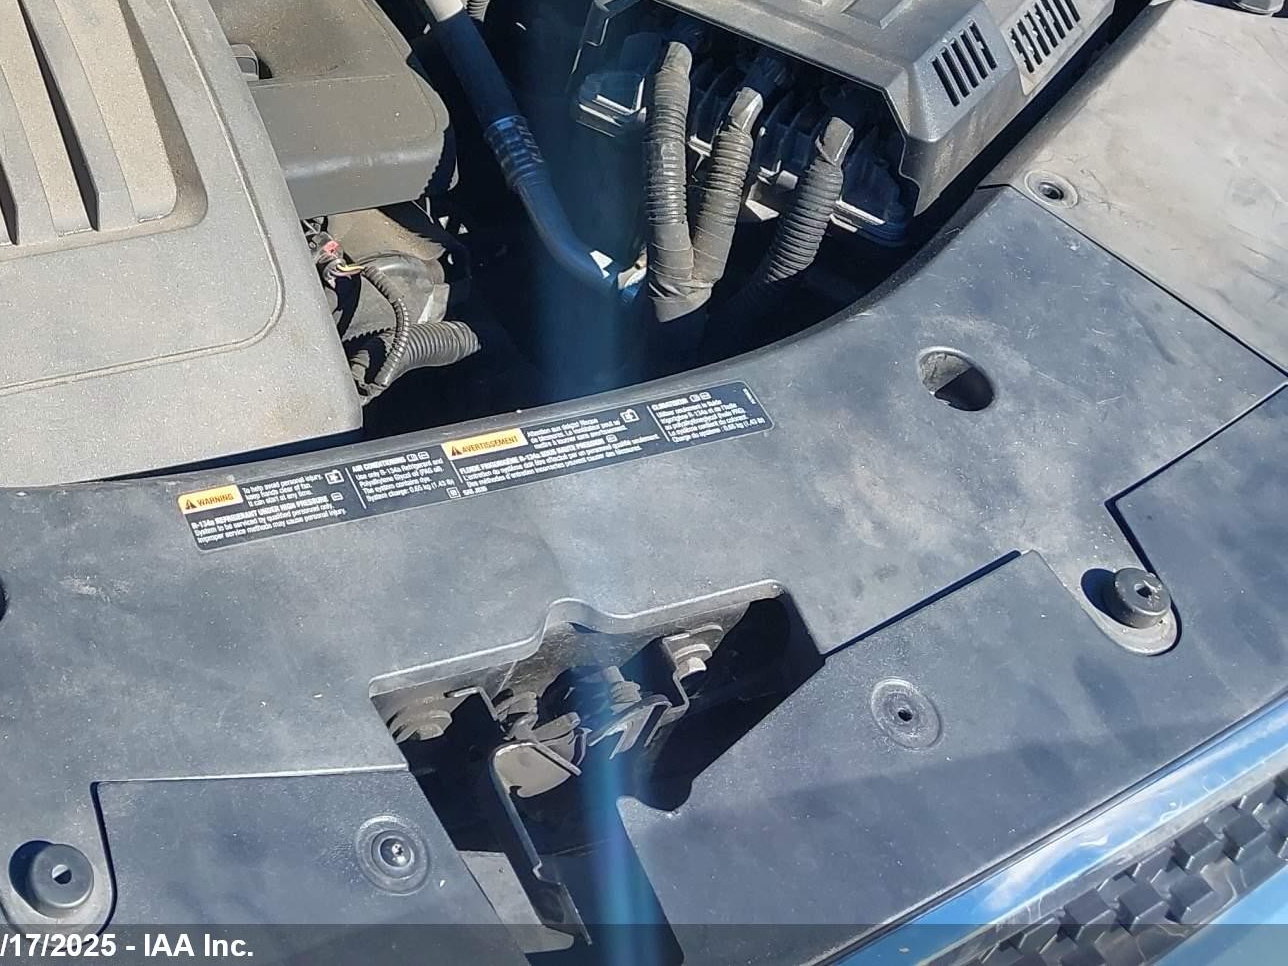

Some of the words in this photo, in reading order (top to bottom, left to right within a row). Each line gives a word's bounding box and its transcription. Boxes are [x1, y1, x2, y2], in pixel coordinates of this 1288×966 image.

[462, 436, 518, 453] AVERTISSEMENT
[363, 457, 406, 470] CONDITIONING
[367, 471, 380, 479] only
[380, 467, 401, 475] R-134a
[401, 460, 432, 472] Refrigerant
[251, 485, 264, 494] help
[264, 482, 280, 490] avoid
[281, 477, 305, 488] personal
[305, 473, 323, 483] injury.
[394, 473, 412, 481] Glycol
[374, 484, 396, 493] system
[395, 479, 419, 488] contains
[197, 494, 234, 506] WARNING
[245, 493, 260, 501] keep
[367, 493, 388, 502] System
[388, 489, 409, 498] charge:
[191, 519, 215, 529] R-134a
[215, 510, 258, 524] REFRIGERANT
[258, 506, 280, 515] UNDER
[280, 502, 296, 511] HIGH
[296, 496, 329, 508] PRESSURE
[194, 527, 217, 537] System
[233, 519, 258, 528] serviced
[266, 511, 292, 523] qualified
[292, 506, 320, 518] personnel
[320, 503, 335, 511] only.
[197, 533, 225, 544] Improper
[225, 529, 246, 538] service
[247, 523, 272, 533] methods
[286, 517, 304, 525] cause
[304, 512, 329, 522] personal
[329, 508, 347, 517] injury.
